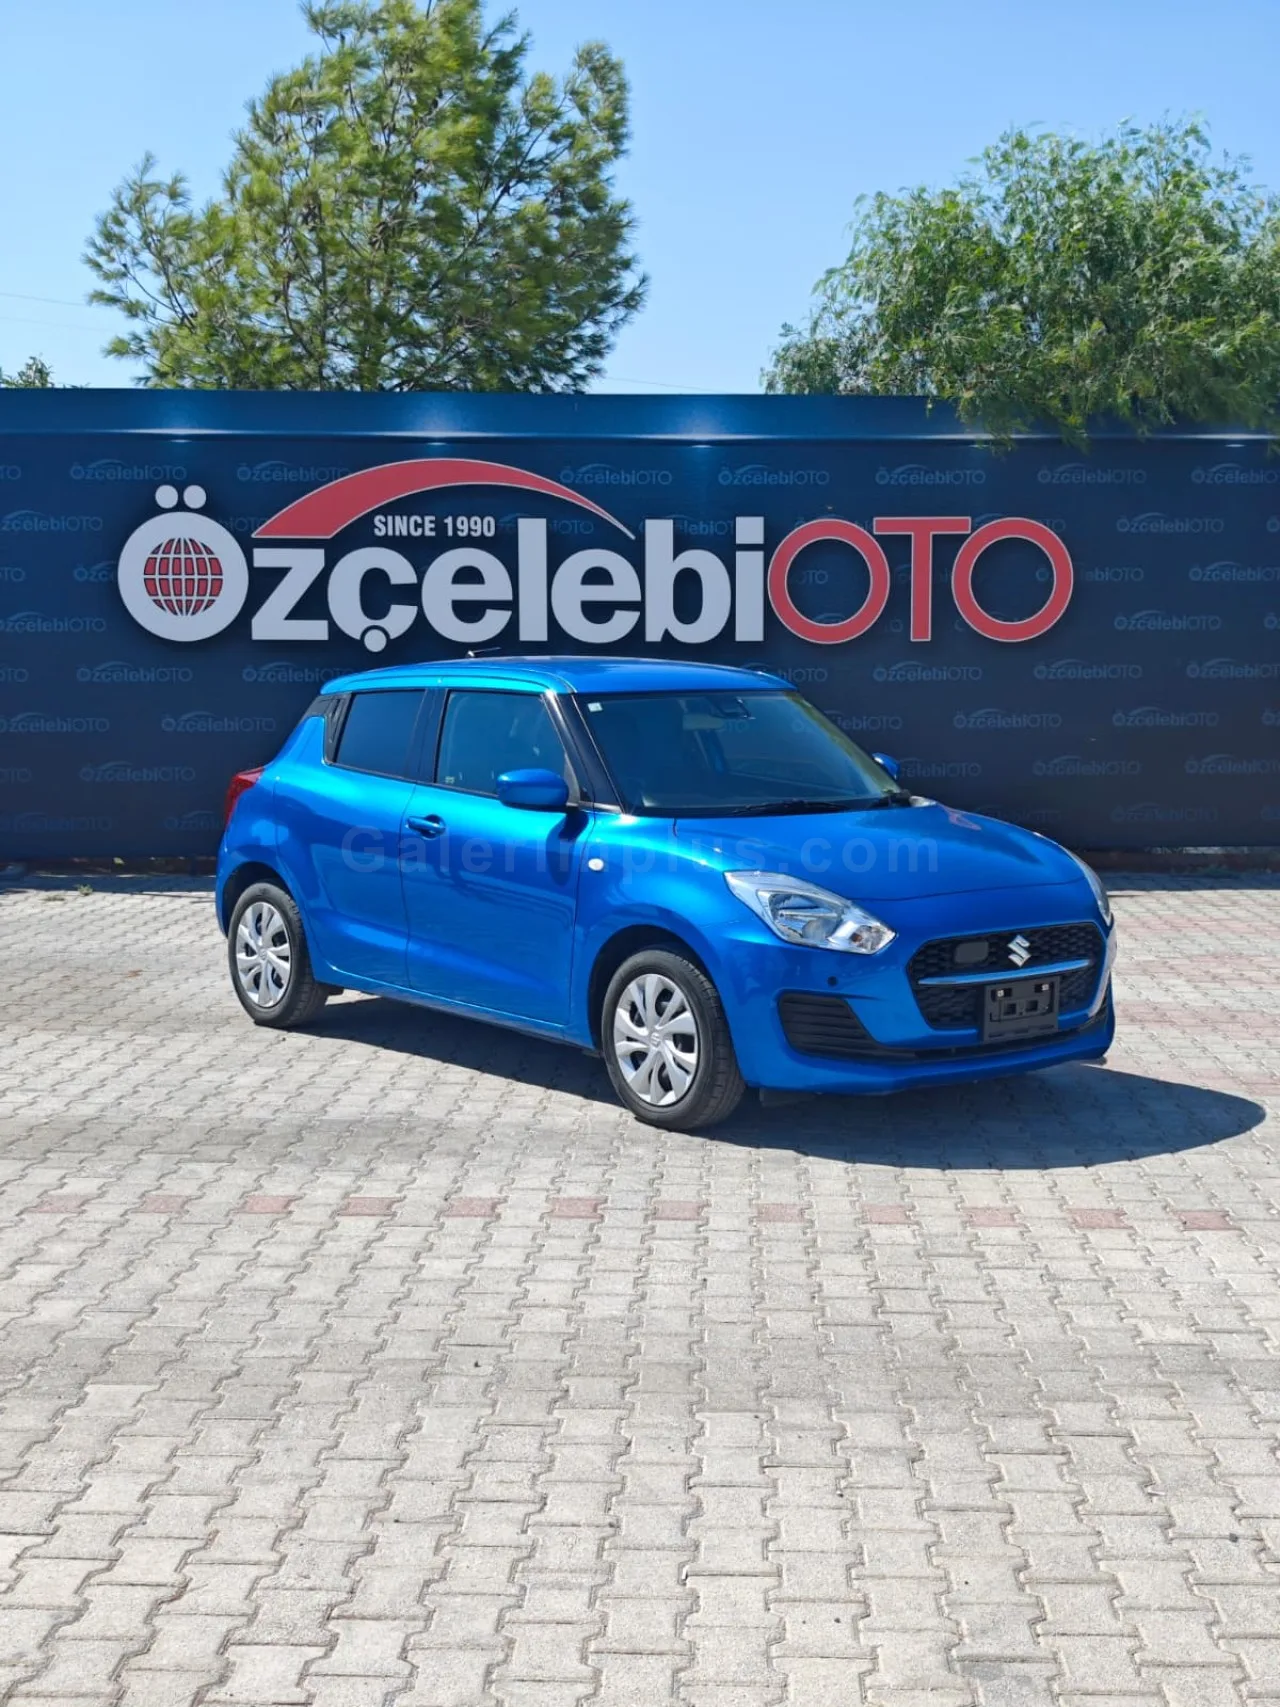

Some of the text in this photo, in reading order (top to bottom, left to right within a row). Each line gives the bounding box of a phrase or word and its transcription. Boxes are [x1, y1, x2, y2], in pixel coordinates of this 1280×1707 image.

[1190, 466, 1280, 485] ÖzçelebiO
[0, 514, 104, 534] zçelebiOTO
[373, 514, 497, 539] SINCE 1990
[116, 483, 1075, 653] ÖzçelebiOTO
[1188, 563, 1280, 583] ÖzçelebiOT
[0, 616, 108, 634] zçelebiOTO
[1186, 660, 1280, 680] ÖzçelebiOT
